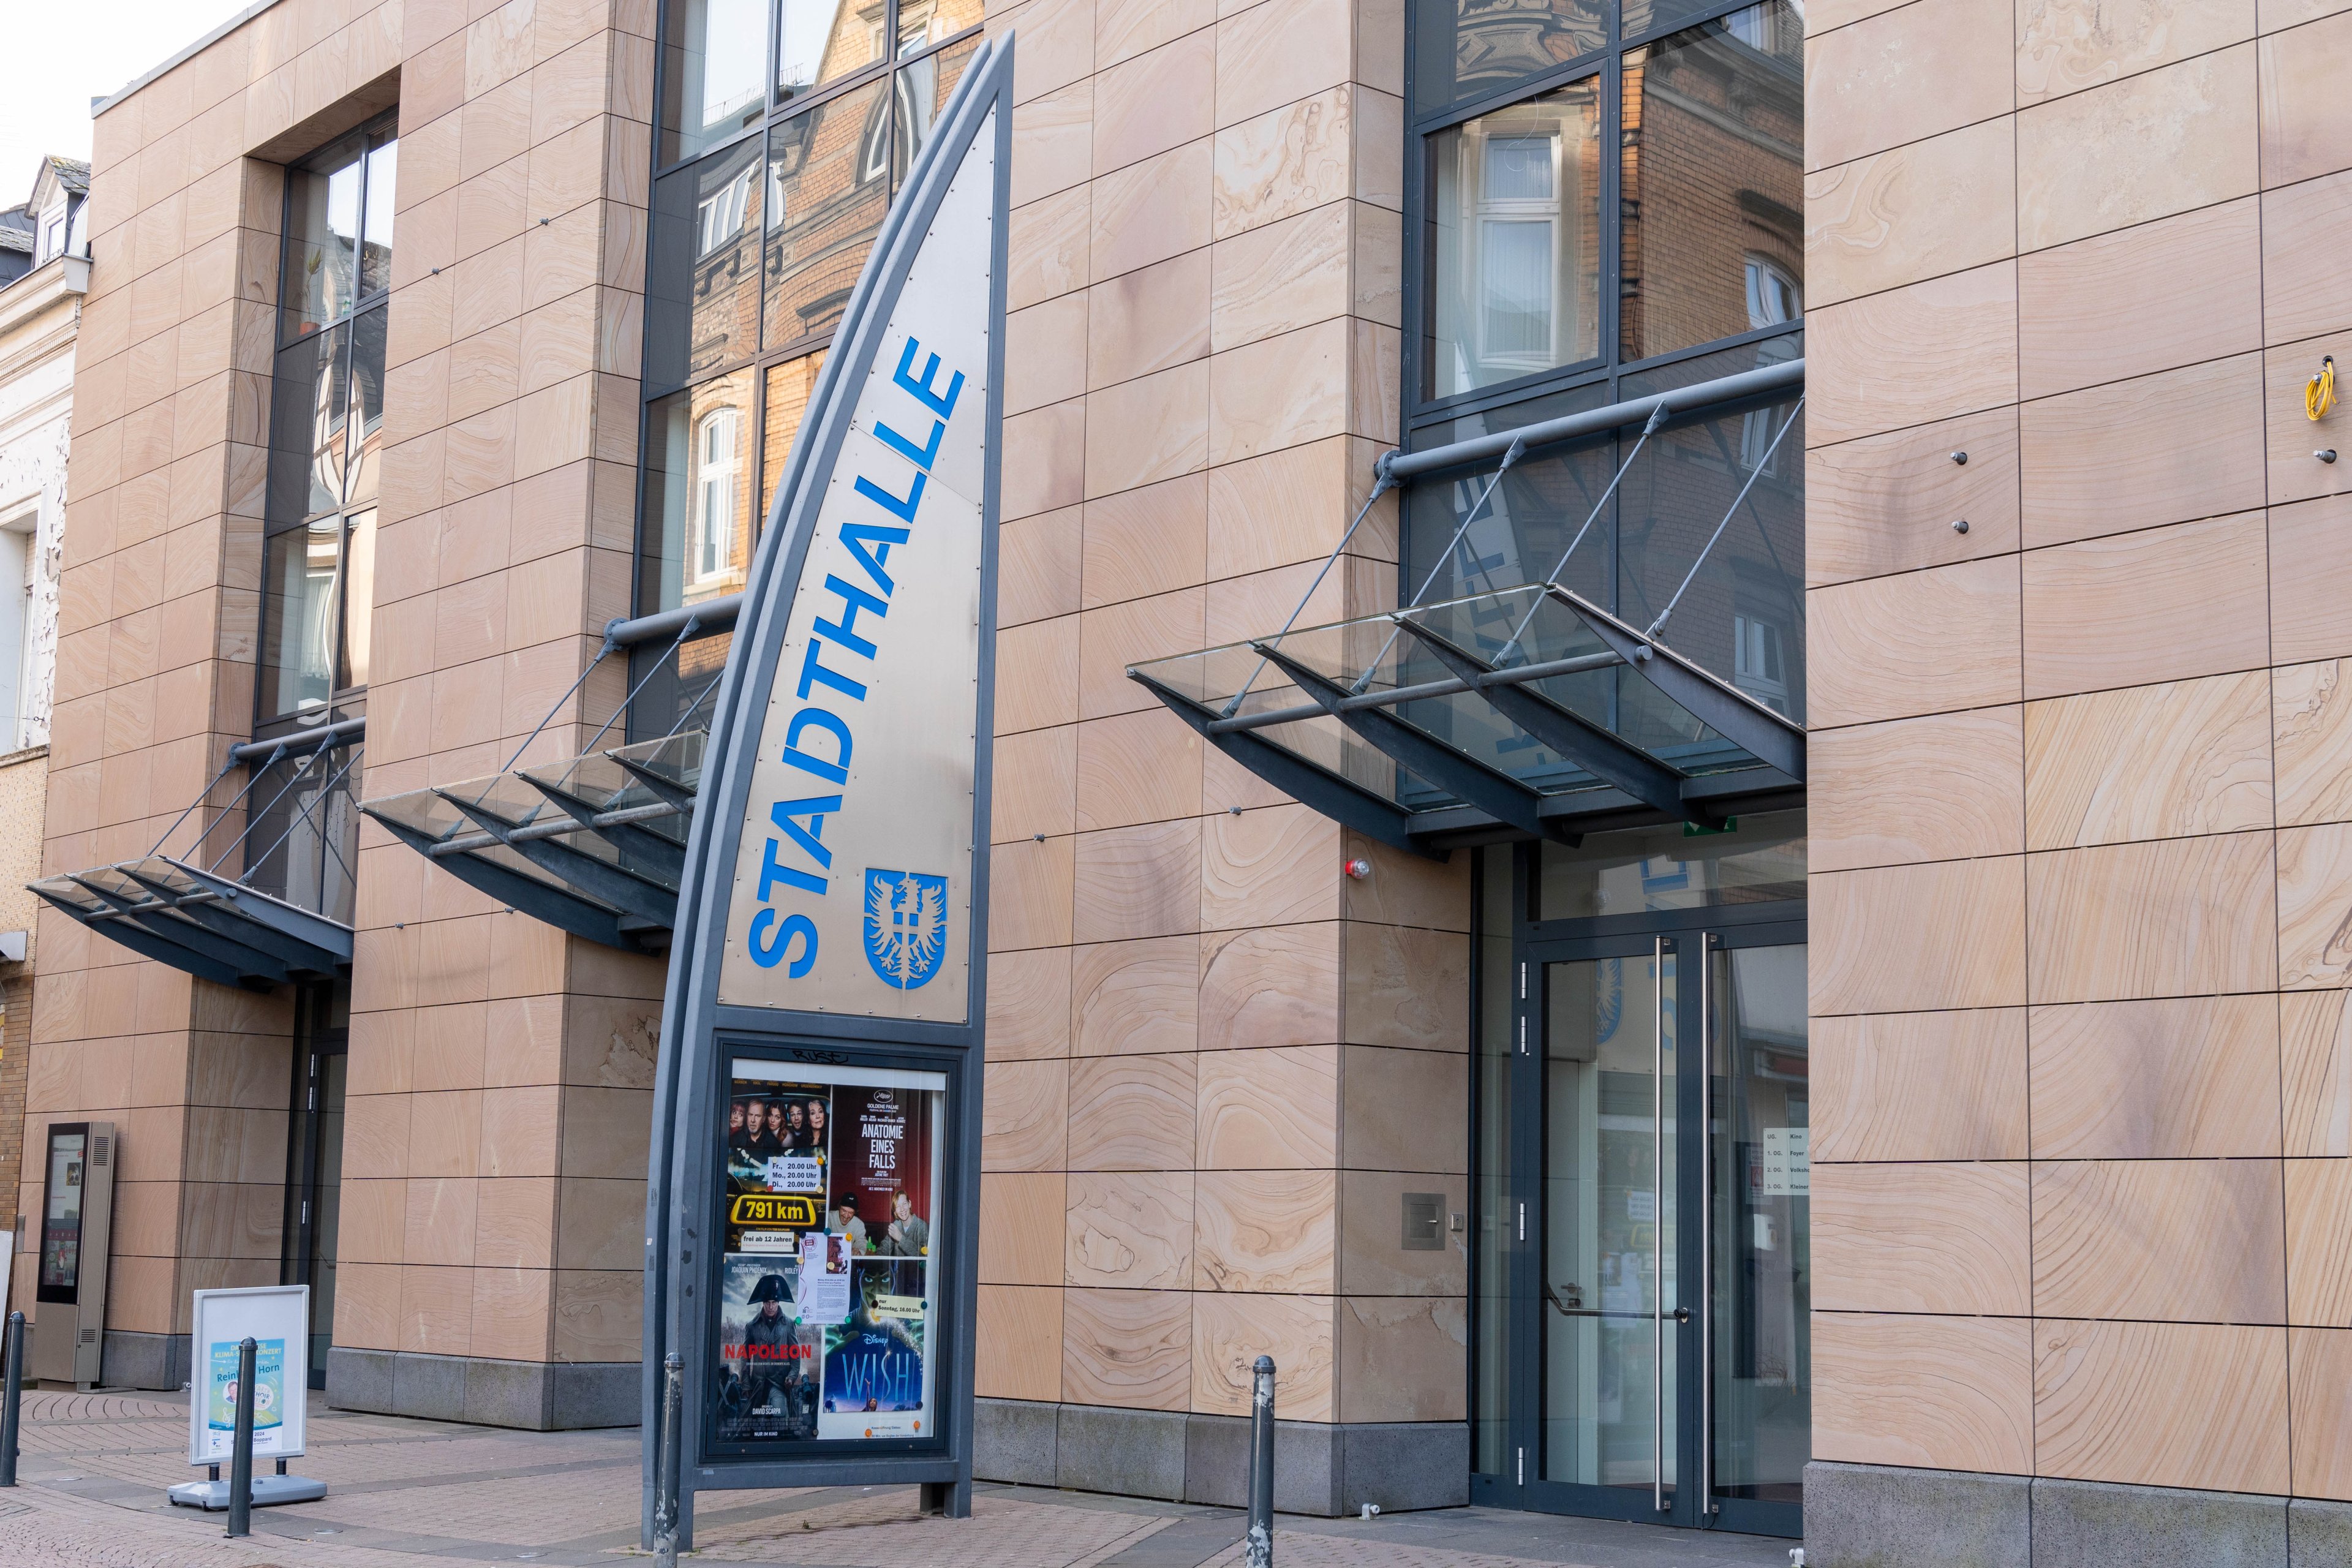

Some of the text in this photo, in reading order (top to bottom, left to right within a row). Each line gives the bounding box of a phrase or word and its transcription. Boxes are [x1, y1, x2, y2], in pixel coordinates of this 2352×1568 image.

[748, 336, 964, 978] STADTHALLE
[861, 1123, 903, 1139] ANATOMIE
[870, 1139, 894, 1153] EINES
[869, 1154, 895, 1169] FALLS
[746, 1201, 803, 1219] 791 km
[725, 1344, 812, 1359] NAPOLEON
[258, 1364, 280, 1374] Horn
[842, 1351, 910, 1401] WISH
